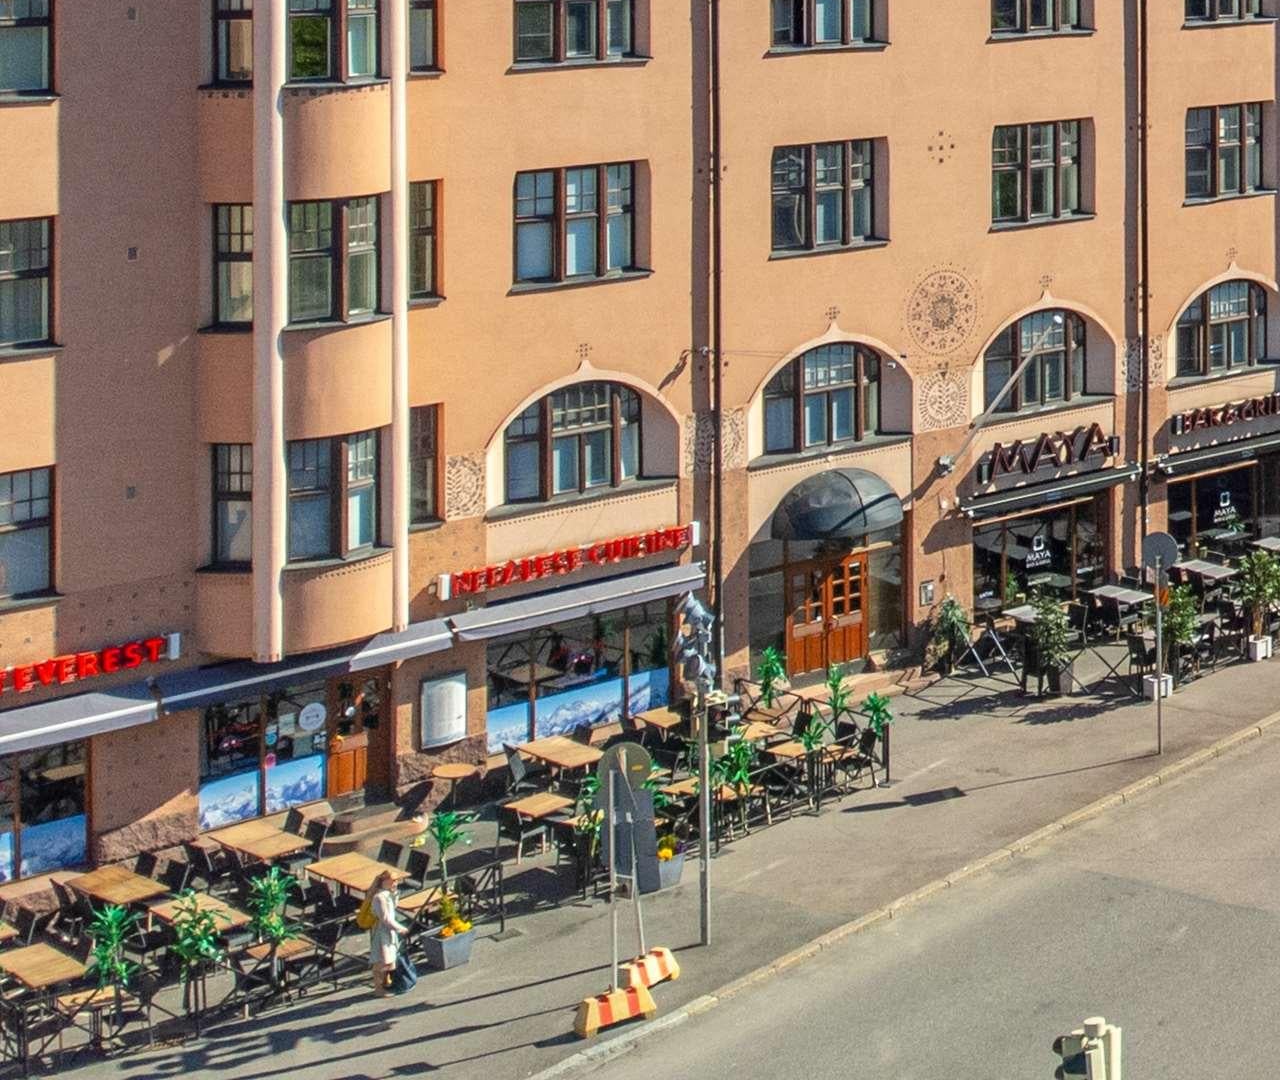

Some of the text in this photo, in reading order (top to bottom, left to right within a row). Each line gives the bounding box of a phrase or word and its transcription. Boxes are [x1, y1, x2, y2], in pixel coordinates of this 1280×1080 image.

[1182, 407, 1218, 435] BAR
[989, 422, 1113, 480] MAYA
[452, 525, 691, 598] NEPALESE CUISINE
[14, 638, 166, 692] EVEREST
